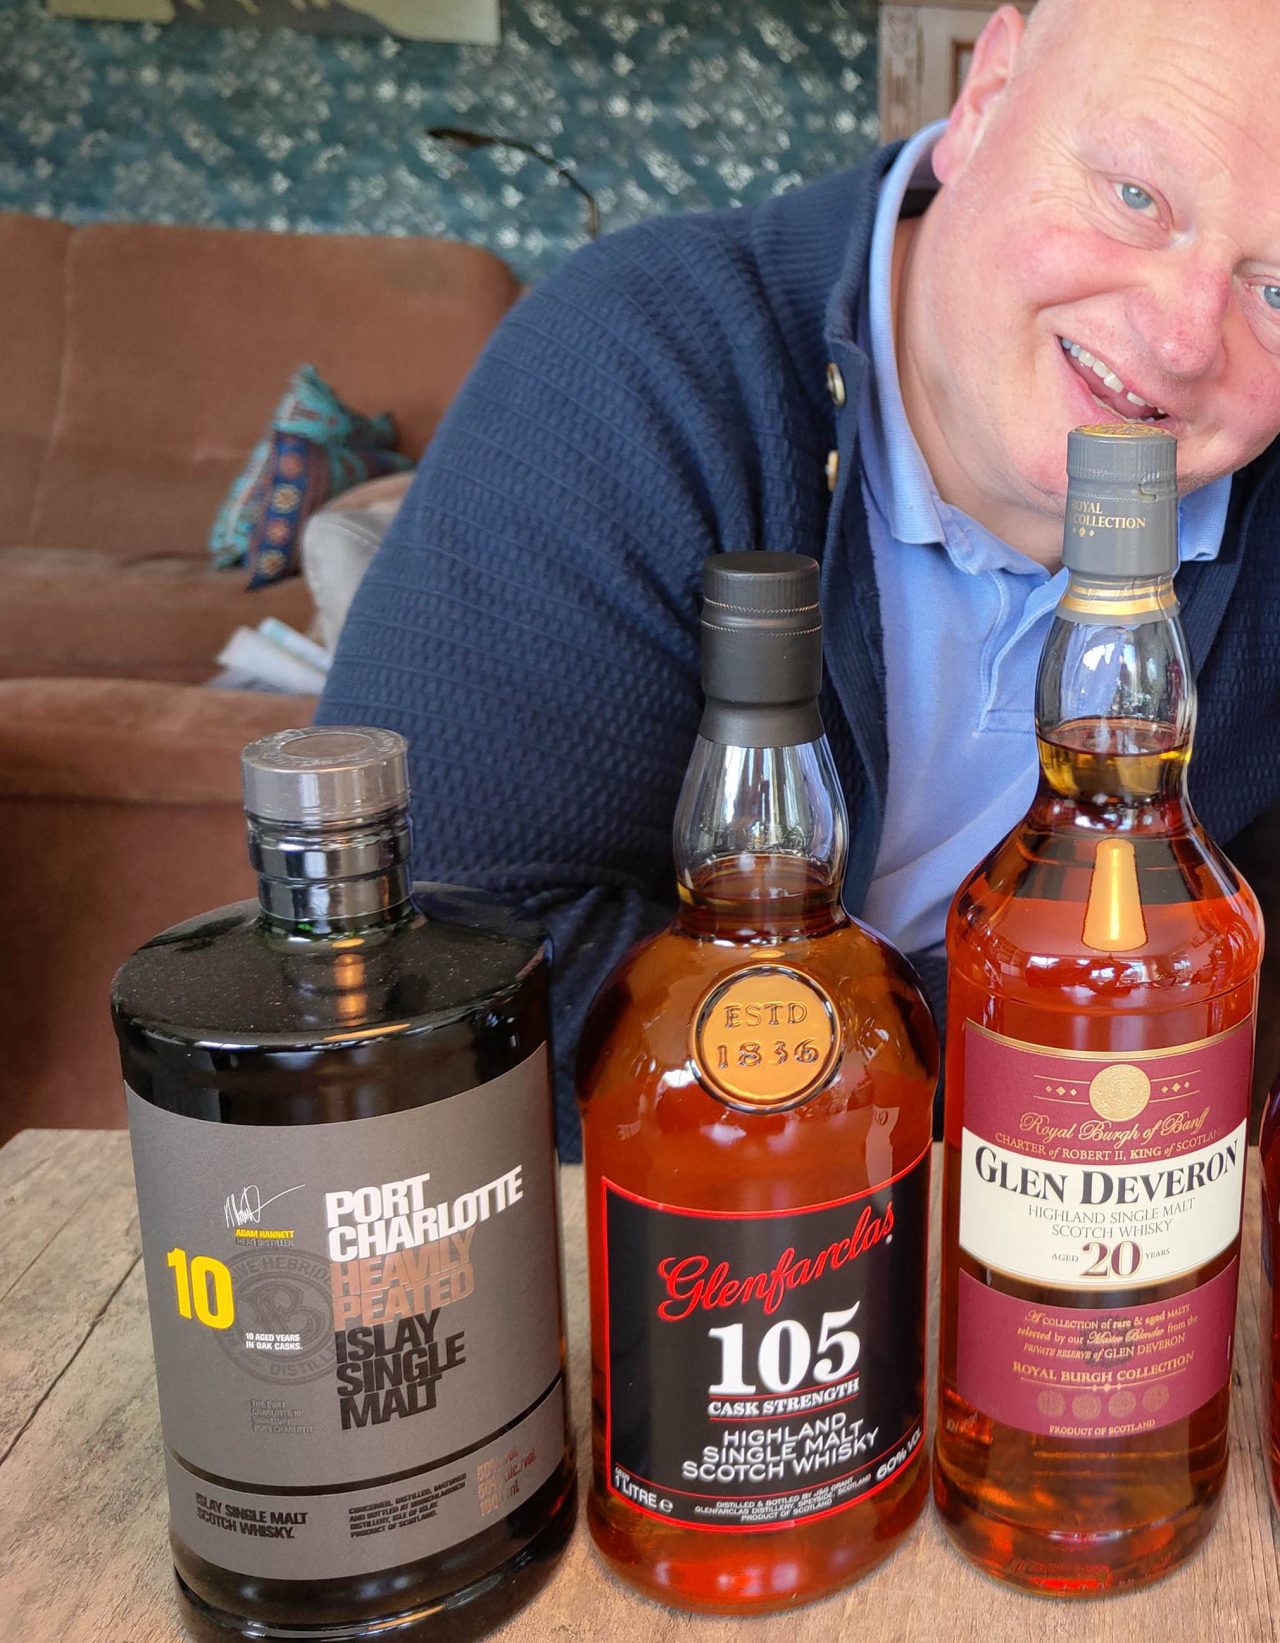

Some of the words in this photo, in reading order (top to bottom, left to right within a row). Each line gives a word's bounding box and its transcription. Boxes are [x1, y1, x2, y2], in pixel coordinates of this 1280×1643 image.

[1072, 499, 1103, 514] ROYAL
[1073, 513, 1146, 529] COLLECTION
[725, 1001, 808, 1028] ESTD
[716, 1037, 819, 1069] 1836
[1019, 1111, 1077, 1143] Royal
[1079, 1119, 1141, 1149] Burgh
[1142, 1123, 1163, 1146] of
[1160, 1105, 1211, 1136] Banff
[995, 1132, 1046, 1155] CHARTER
[1048, 1147, 1061, 1158] of
[1062, 1149, 1111, 1161] ROBERT
[1130, 1146, 1162, 1160] KING
[1164, 1143, 1176, 1157] of
[1175, 1128, 1222, 1152] SCOTLAN
[975, 1145, 1069, 1204] GLEN
[1079, 1139, 1239, 1205] DEVERON
[325, 1172, 431, 1228] PORT
[328, 1164, 524, 1263] CHARLOTTE
[1028, 1204, 1106, 1224] HIGHLAND
[1110, 1208, 1159, 1224] SINGLE
[1162, 1196, 1197, 1217] MALT
[236, 1228, 258, 1238] ADAM
[258, 1230, 295, 1239] HANNETT
[1051, 1223, 1113, 1239] SCOTCH
[1119, 1219, 1174, 1238] WHISKY
[330, 1227, 477, 1298] HEAVILY
[656, 1201, 895, 1321] Glenfarclas
[1051, 1253, 1079, 1263] AGED
[1079, 1240, 1143, 1279] 20
[1145, 1248, 1171, 1259] YEARS
[166, 1247, 235, 1330] 10
[332, 1262, 475, 1332] PEATED
[245, 1332, 254, 1341] 10
[255, 1333, 275, 1342] AGED
[275, 1334, 300, 1342] YEARS
[334, 1306, 442, 1365] ISLAY
[1042, 1316, 1098, 1329] COLLECTION
[1054, 1331, 1067, 1345] by
[1067, 1335, 1085, 1344] our
[245, 1341, 254, 1349] IN
[256, 1342, 273, 1350] OAK
[708, 1300, 861, 1395] 105
[1104, 1346, 1135, 1359] GLEN
[1137, 1332, 1185, 1356] DEVERON
[336, 1330, 467, 1398] SINGLE
[1012, 1360, 1058, 1380] ROYAL
[1061, 1370, 1114, 1382] BURGH
[1116, 1350, 1195, 1382] COLLECTION
[339, 1373, 443, 1431] MALT
[708, 1400, 760, 1417] CASK
[762, 1377, 860, 1413] STRENGTH
[702, 1443, 795, 1464] SINGLE
[804, 1418, 865, 1453] MALT
[723, 1412, 847, 1446] HIGHLAND
[1049, 1425, 1093, 1436] PRODUCT
[1094, 1426, 1107, 1436] OF
[1108, 1419, 1156, 1435] SCOTLAND
[682, 1458, 785, 1482] SCOTCH
[792, 1426, 880, 1475] WHISKY
[876, 1447, 907, 1482] 60%
[196, 1491, 222, 1514] ISLAY
[225, 1503, 267, 1523] SINGLE
[270, 1511, 308, 1525] MALT
[622, 1479, 658, 1509] LITRE
[694, 1505, 750, 1515] GLENFARCLAS
[716, 1500, 755, 1509] DISTILLED
[766, 1495, 800, 1507] BOTTLED
[741, 1513, 778, 1522] PRODUCT
[793, 1498, 834, 1515] SCOTLAND
[197, 1506, 237, 1533] SCOTCH
